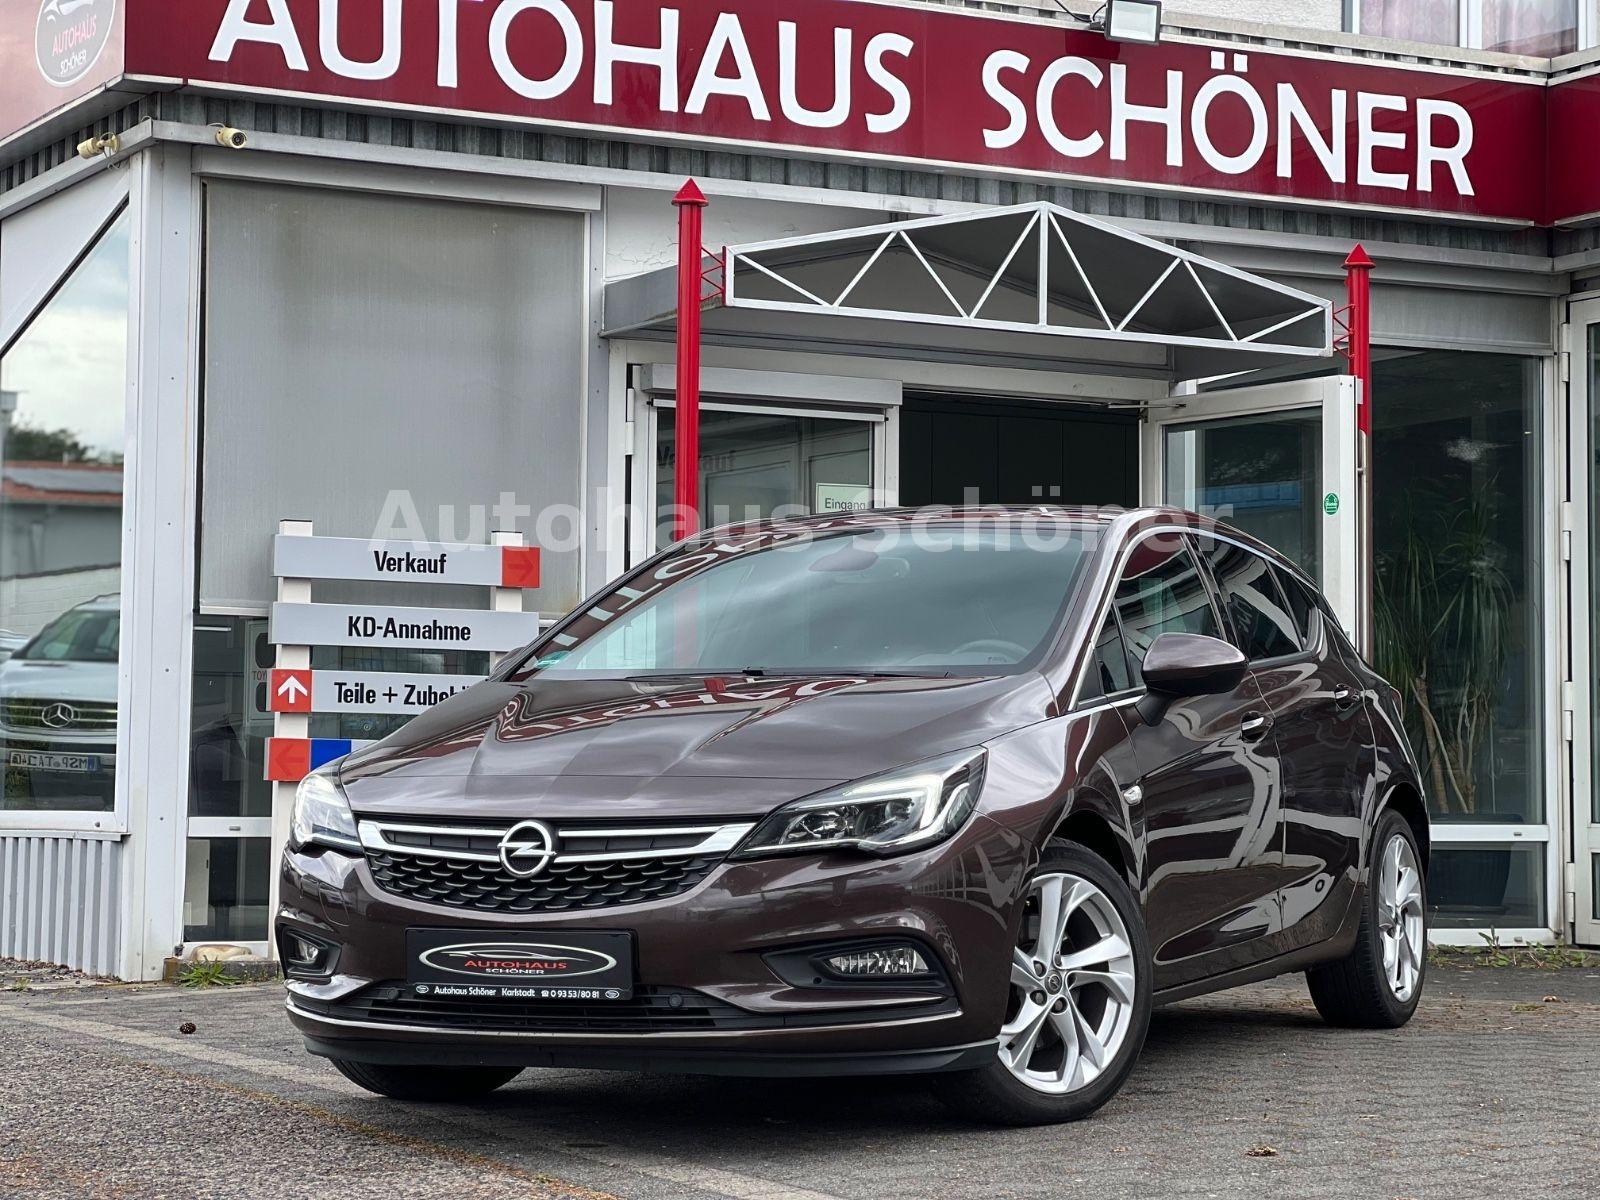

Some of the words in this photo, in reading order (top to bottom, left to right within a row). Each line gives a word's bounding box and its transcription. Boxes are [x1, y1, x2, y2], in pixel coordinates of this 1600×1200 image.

[51, 13, 98, 57] AUTOHAUS
[207, 0, 914, 135] AUTOHAUS
[981, 49, 1475, 197] SCHÖNER
[824, 497, 866, 512] Eingang
[373, 550, 447, 574] Verkauf
[347, 615, 472, 641] KD-Annahme
[334, 681, 377, 704] Teile
[382, 686, 398, 703] +
[464, 960, 568, 969] AUTOHAUS
[434, 986, 467, 995] Autohaus
[468, 986, 496, 996] Schöner
[501, 987, 535, 997] Karlstadt
